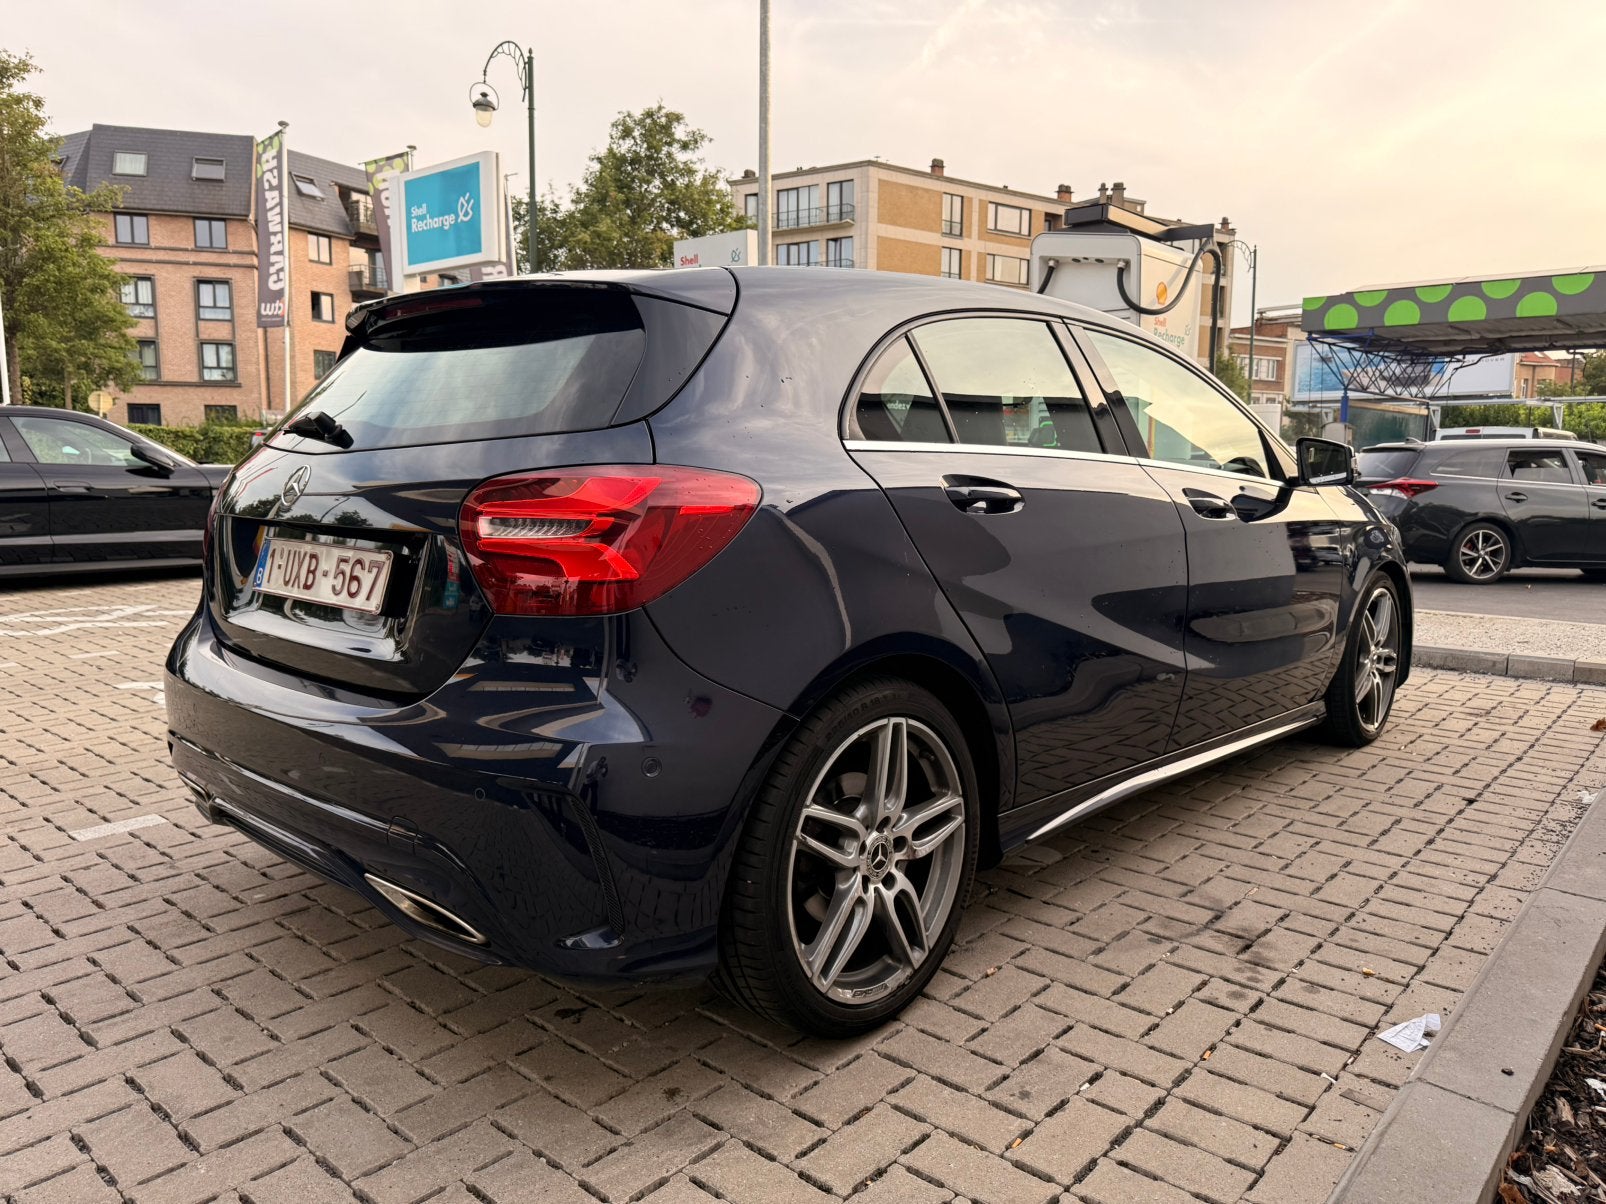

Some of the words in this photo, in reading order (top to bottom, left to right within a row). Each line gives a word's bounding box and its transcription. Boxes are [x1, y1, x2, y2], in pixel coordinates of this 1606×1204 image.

[410, 203, 427, 217] Shell
[411, 212, 456, 233] Recharge
[680, 254, 699, 266] Shell
[1154, 316, 1167, 328] Shell
[266, 547, 386, 602] 1-UXB-567
